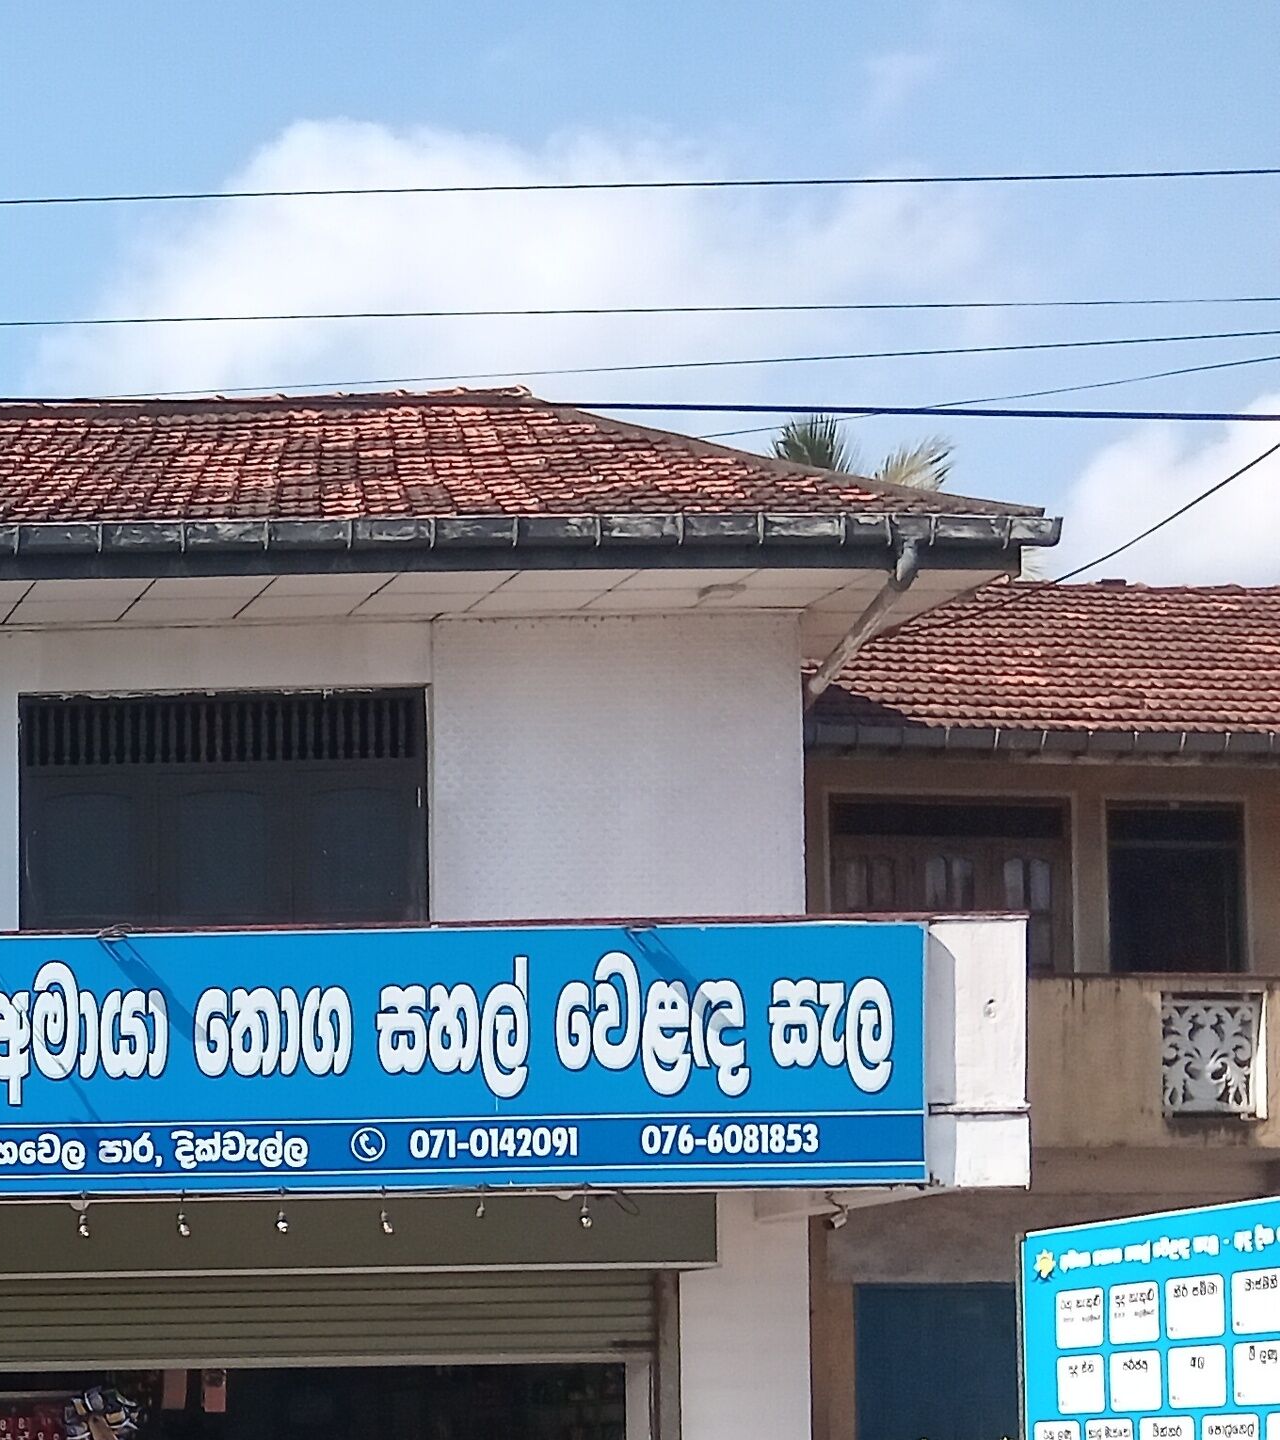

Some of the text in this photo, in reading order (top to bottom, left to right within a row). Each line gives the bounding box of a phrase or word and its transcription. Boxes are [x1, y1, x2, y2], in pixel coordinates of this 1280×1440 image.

[193, 985, 354, 1078] තොග
[376, 956, 529, 1099] සහල්
[768, 977, 895, 1094] සැල
[409, 1126, 579, 1159] 071-0142091
[641, 1124, 819, 1155] 076-6081853
